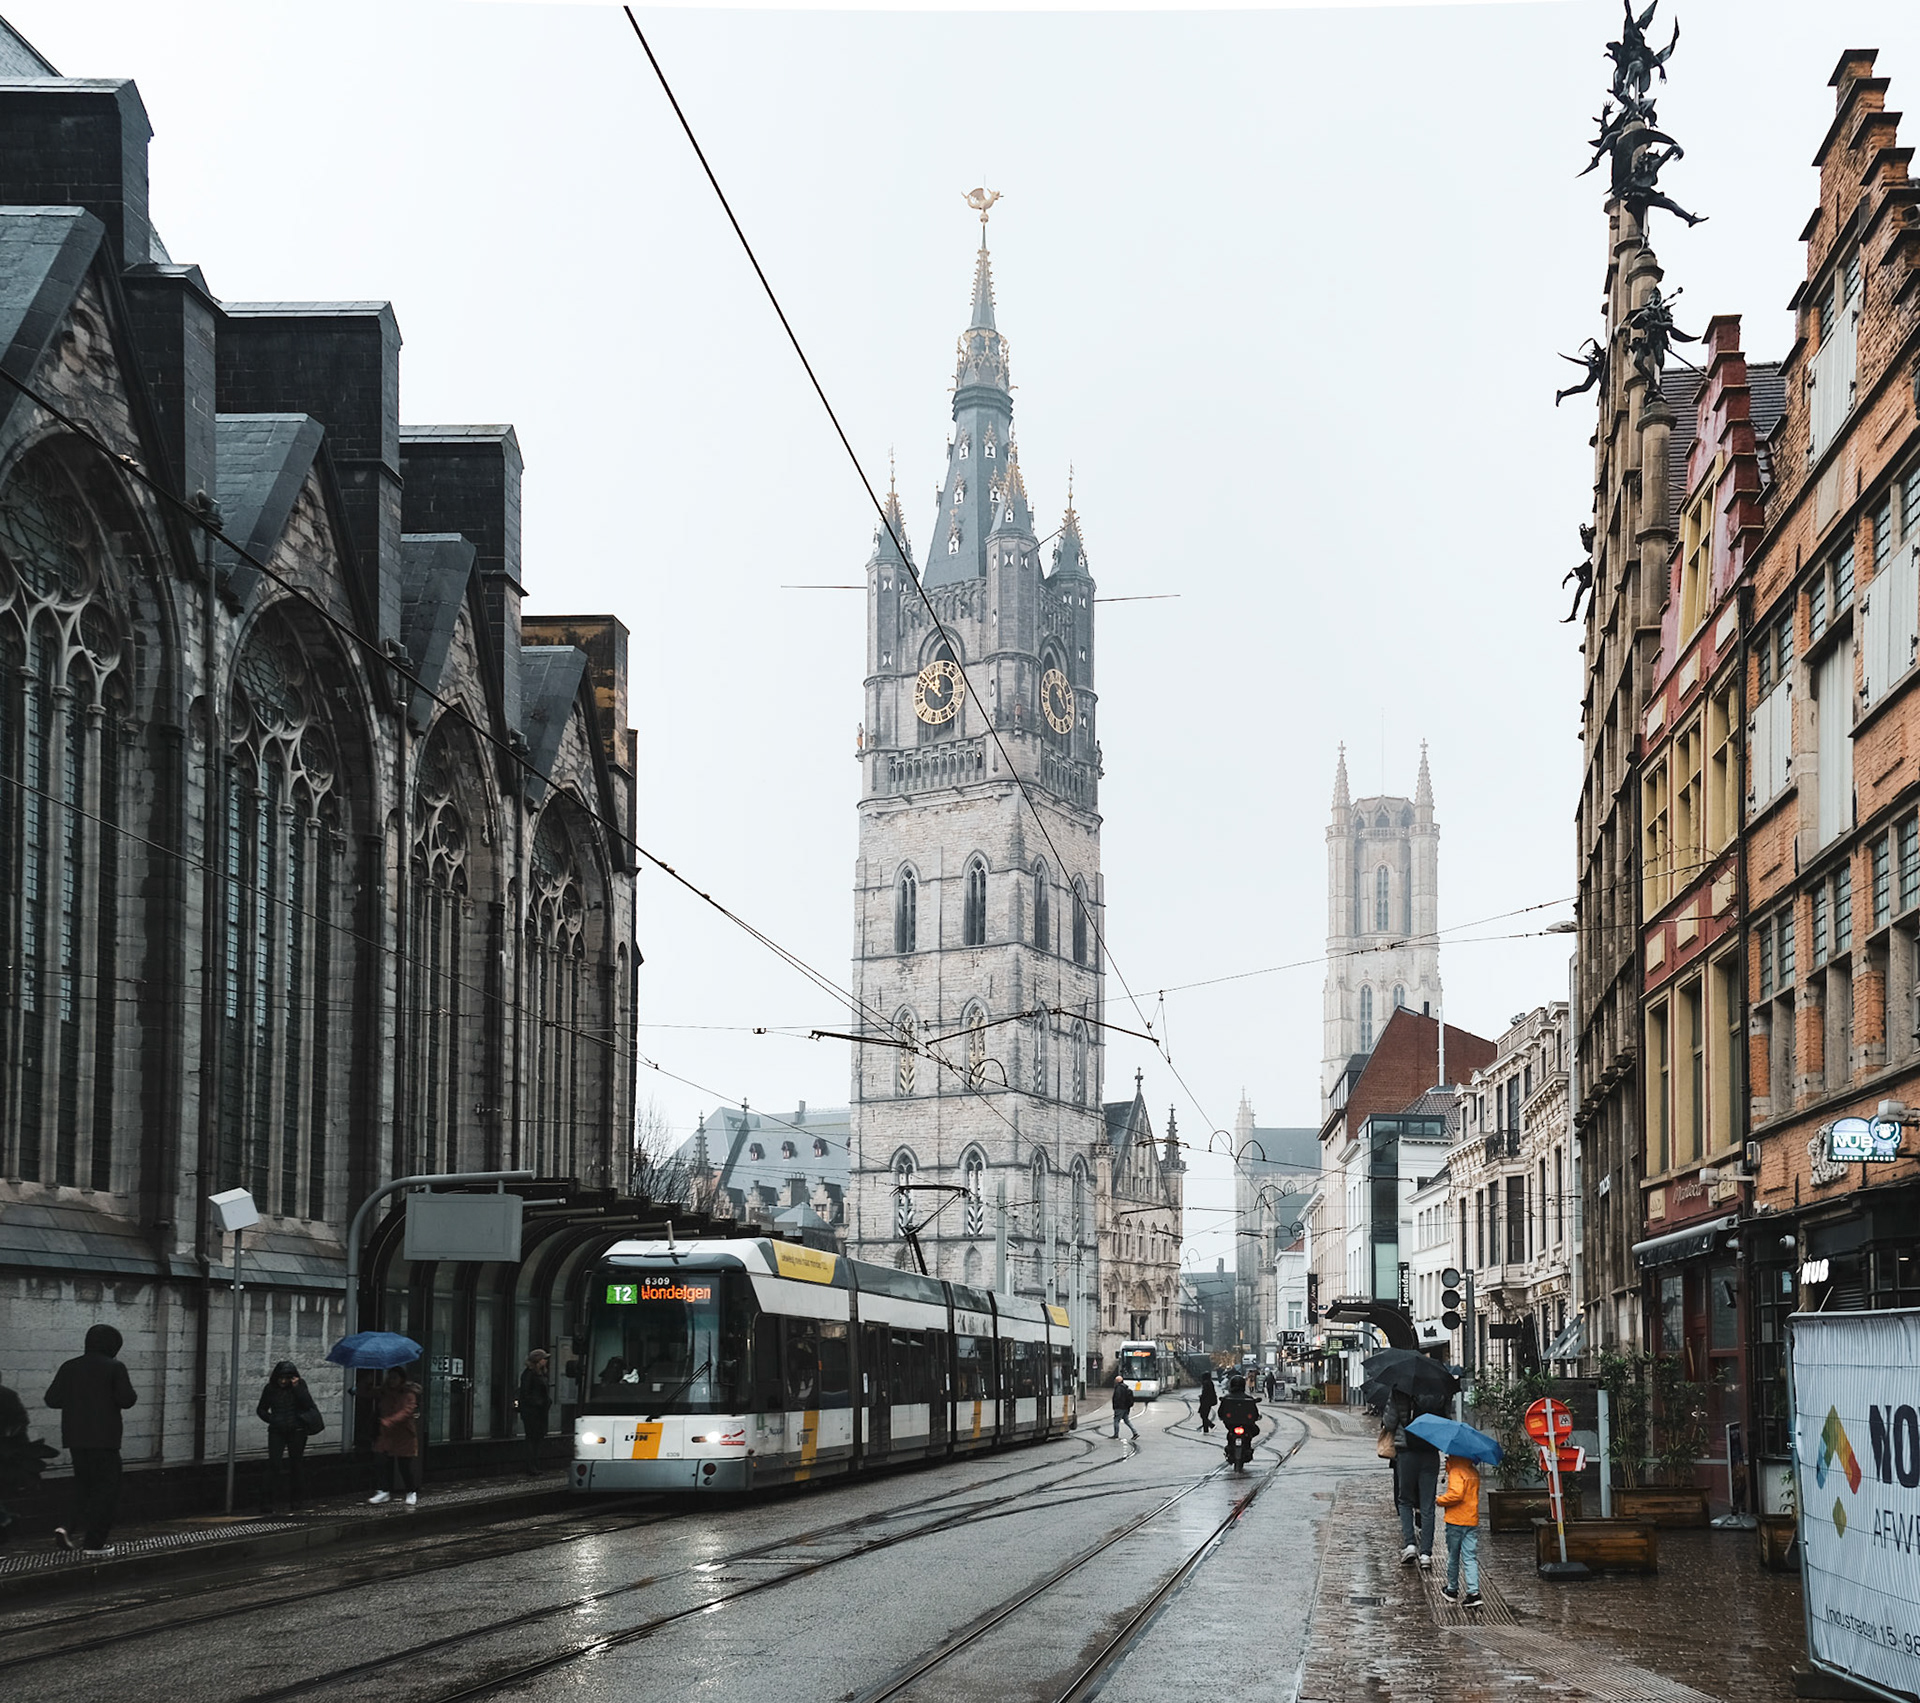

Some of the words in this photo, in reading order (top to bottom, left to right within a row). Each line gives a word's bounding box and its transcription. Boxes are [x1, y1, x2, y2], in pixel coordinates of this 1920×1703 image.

[1833, 1135, 1874, 1148] NUB
[645, 1277, 670, 1285] 6309
[1801, 1258, 1829, 1285] NUB
[613, 1286, 632, 1302] T2
[1401, 1269, 1409, 1308] Leonidas
[1869, 1404, 1920, 1488] NO
